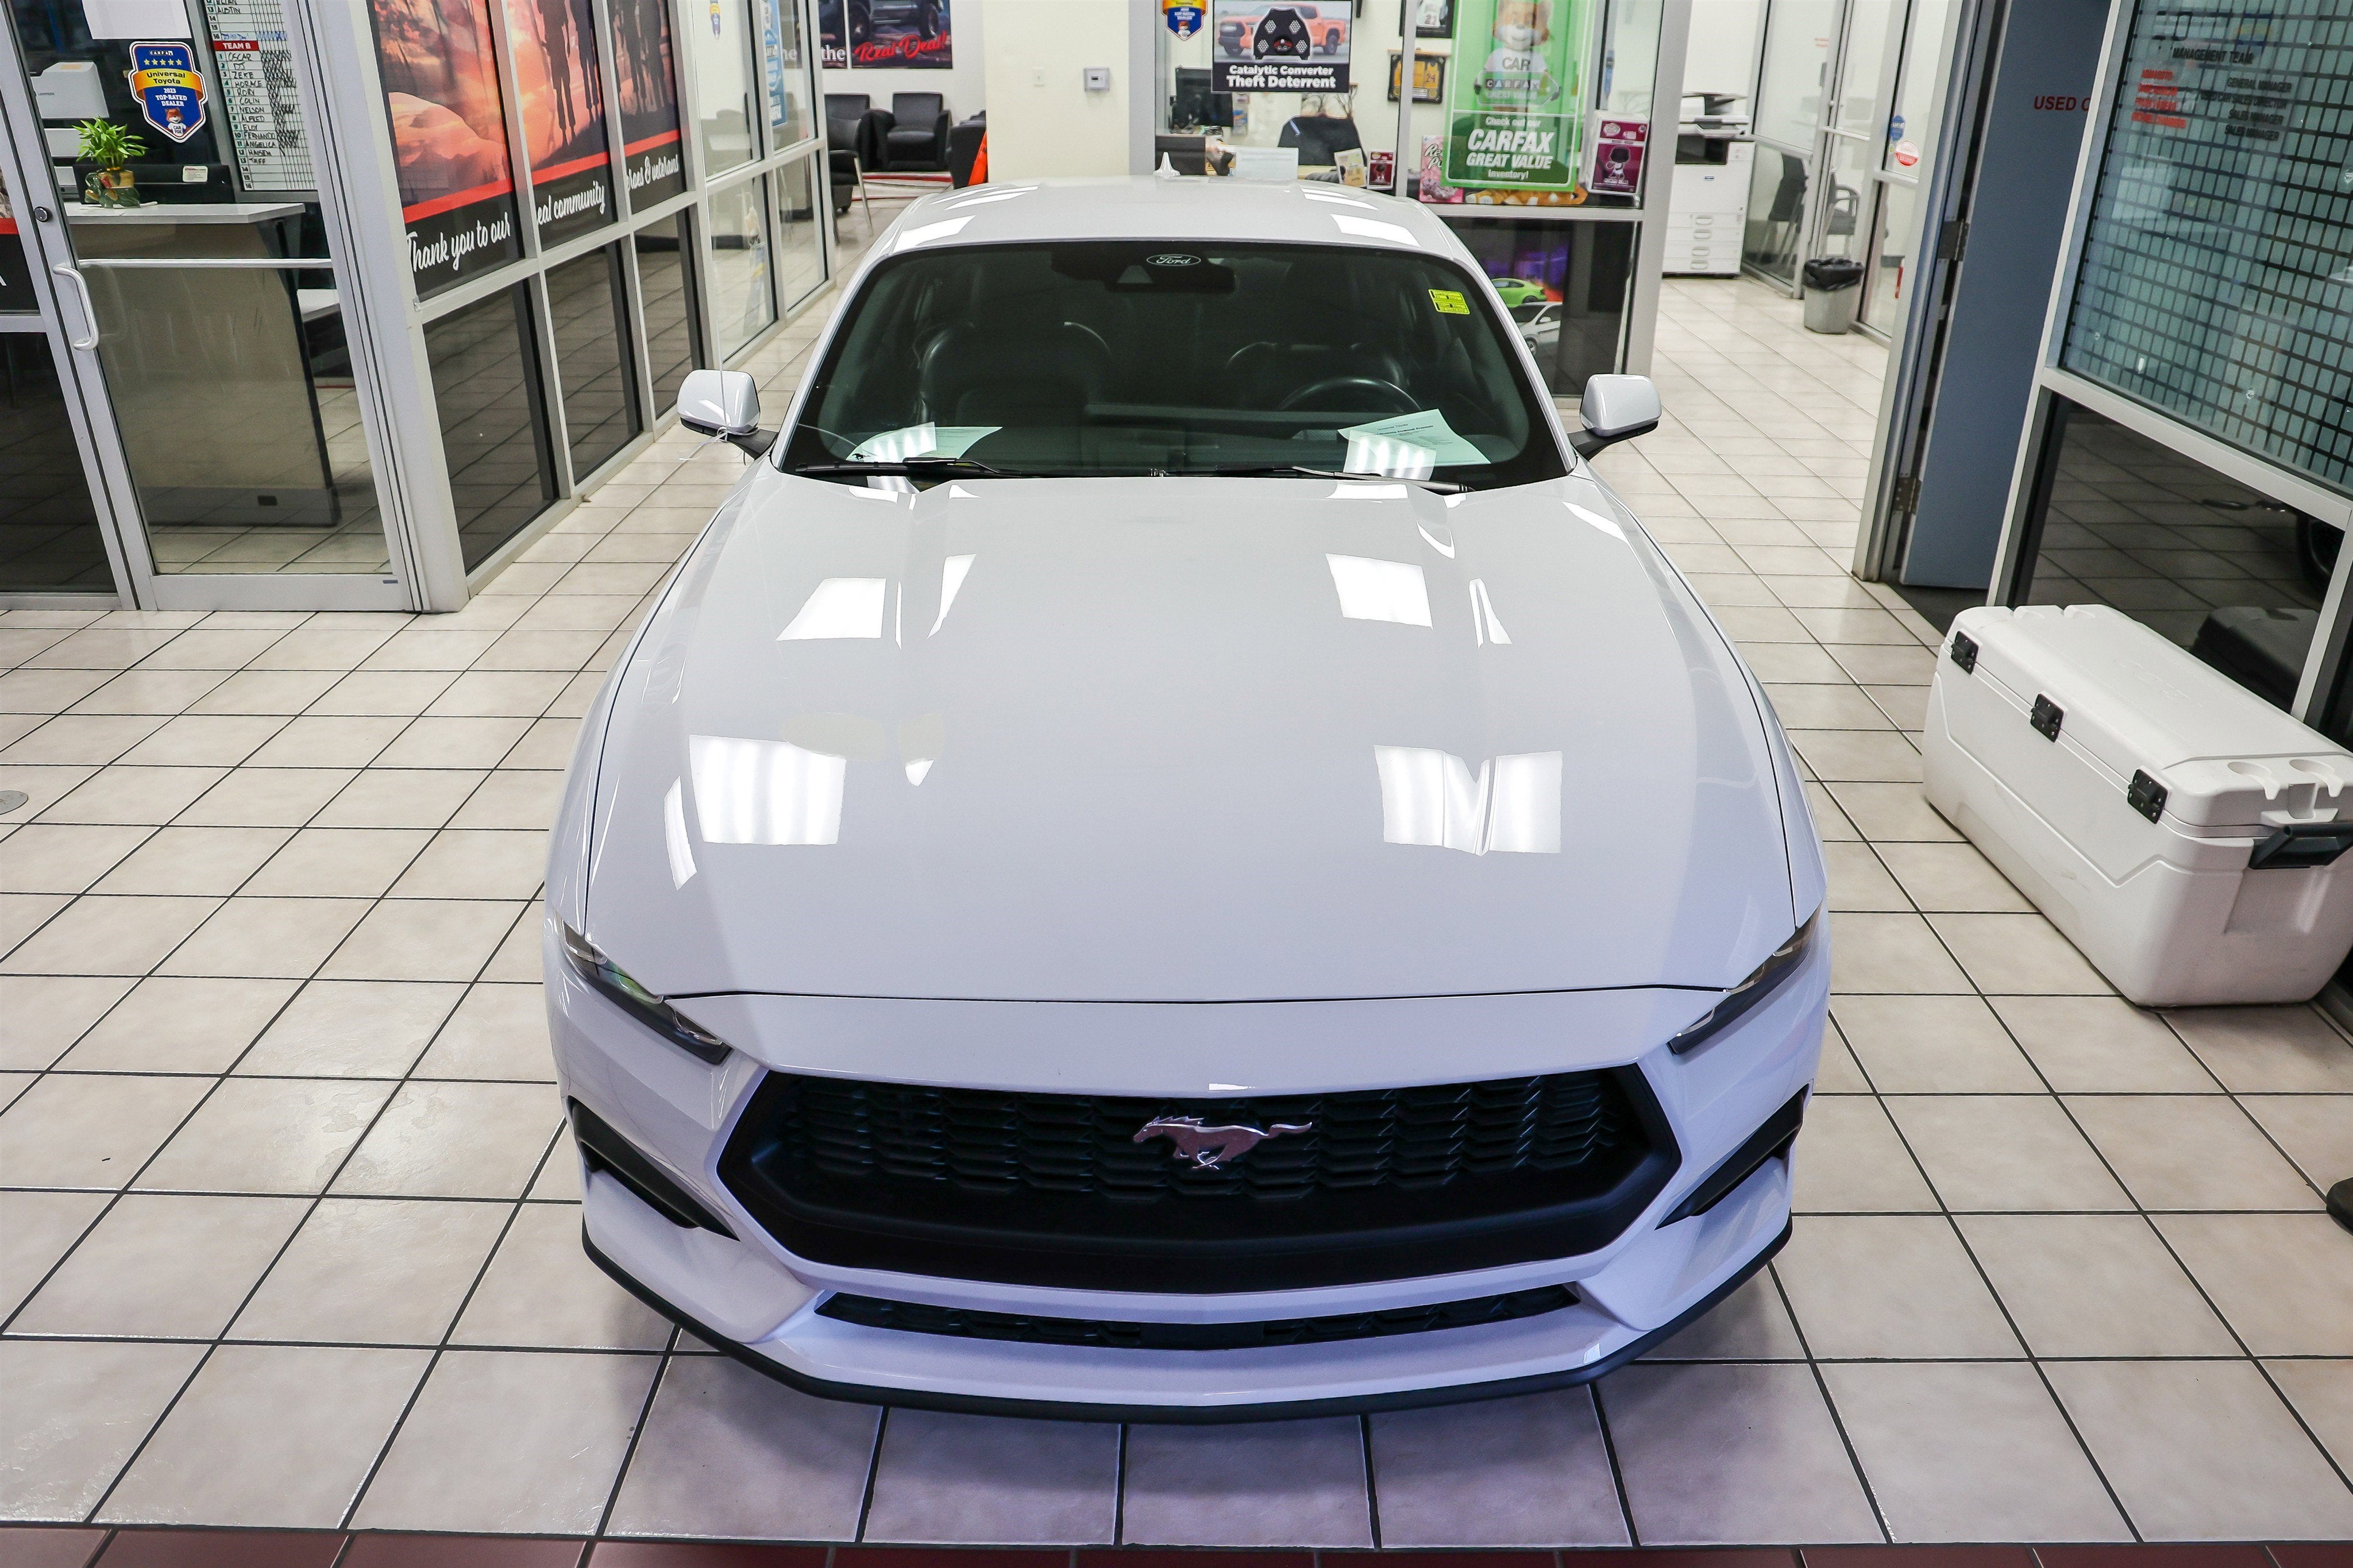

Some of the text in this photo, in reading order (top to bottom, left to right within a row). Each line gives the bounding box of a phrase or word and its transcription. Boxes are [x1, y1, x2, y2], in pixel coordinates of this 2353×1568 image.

[820, 44, 847, 61] the
[854, 41, 896, 62] Real
[898, 30, 947, 58] Deal!
[1502, 57, 1531, 70] CAR
[2172, 47, 2253, 64] MANAGEMENT TEAM
[1229, 64, 1334, 76] Catalytic Converter
[1226, 75, 1336, 88] Theft Deterrent
[2034, 95, 2091, 111] USED C
[1467, 129, 1554, 153] CARFAX
[1425, 144, 1442, 157] Re
[651, 154, 679, 181] veterans
[1466, 152, 1553, 170] GREAT VALUE
[554, 180, 605, 219] community
[406, 211, 510, 272] Thank you to our
[1156, 255, 1191, 264] Ford
